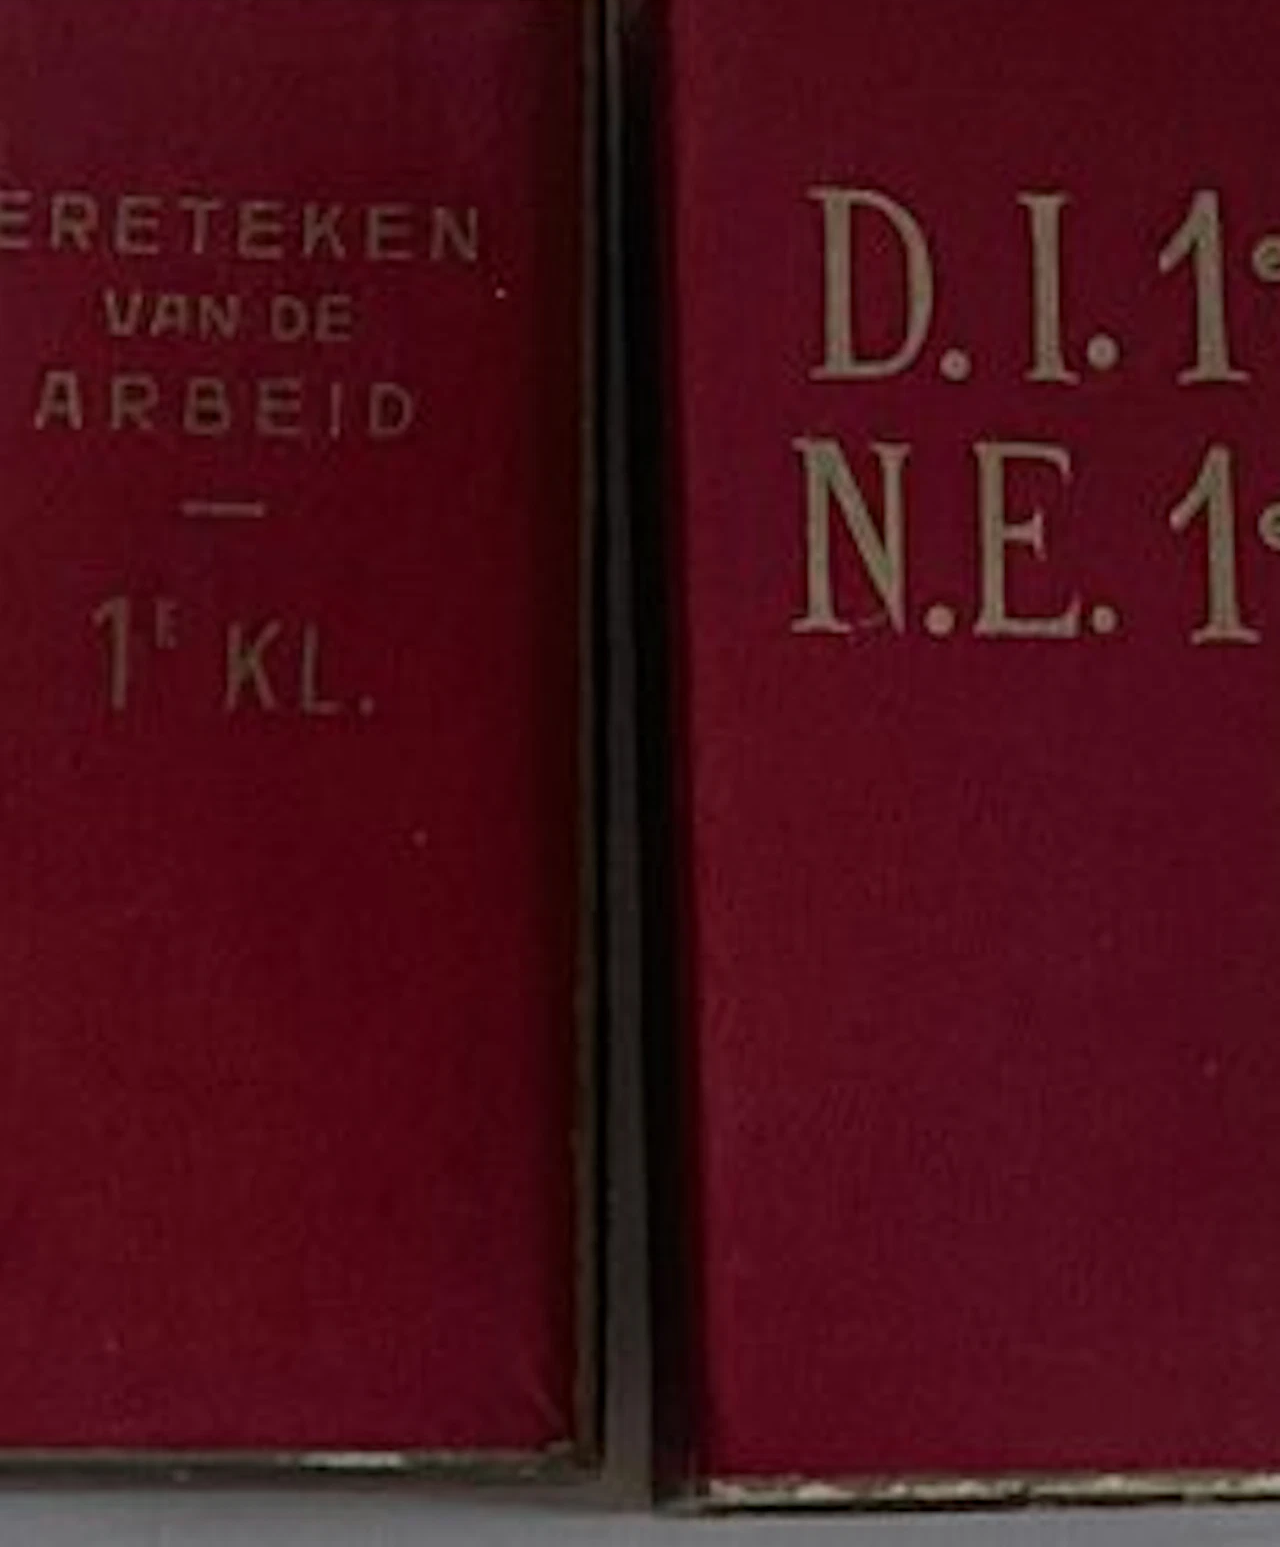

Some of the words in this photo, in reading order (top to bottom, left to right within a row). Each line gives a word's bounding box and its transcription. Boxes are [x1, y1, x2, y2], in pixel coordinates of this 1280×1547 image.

[102, 288, 240, 340] VAN
[269, 294, 353, 343] DE
[33, 370, 415, 438] ARBEID
[225, 619, 375, 717] KL.
